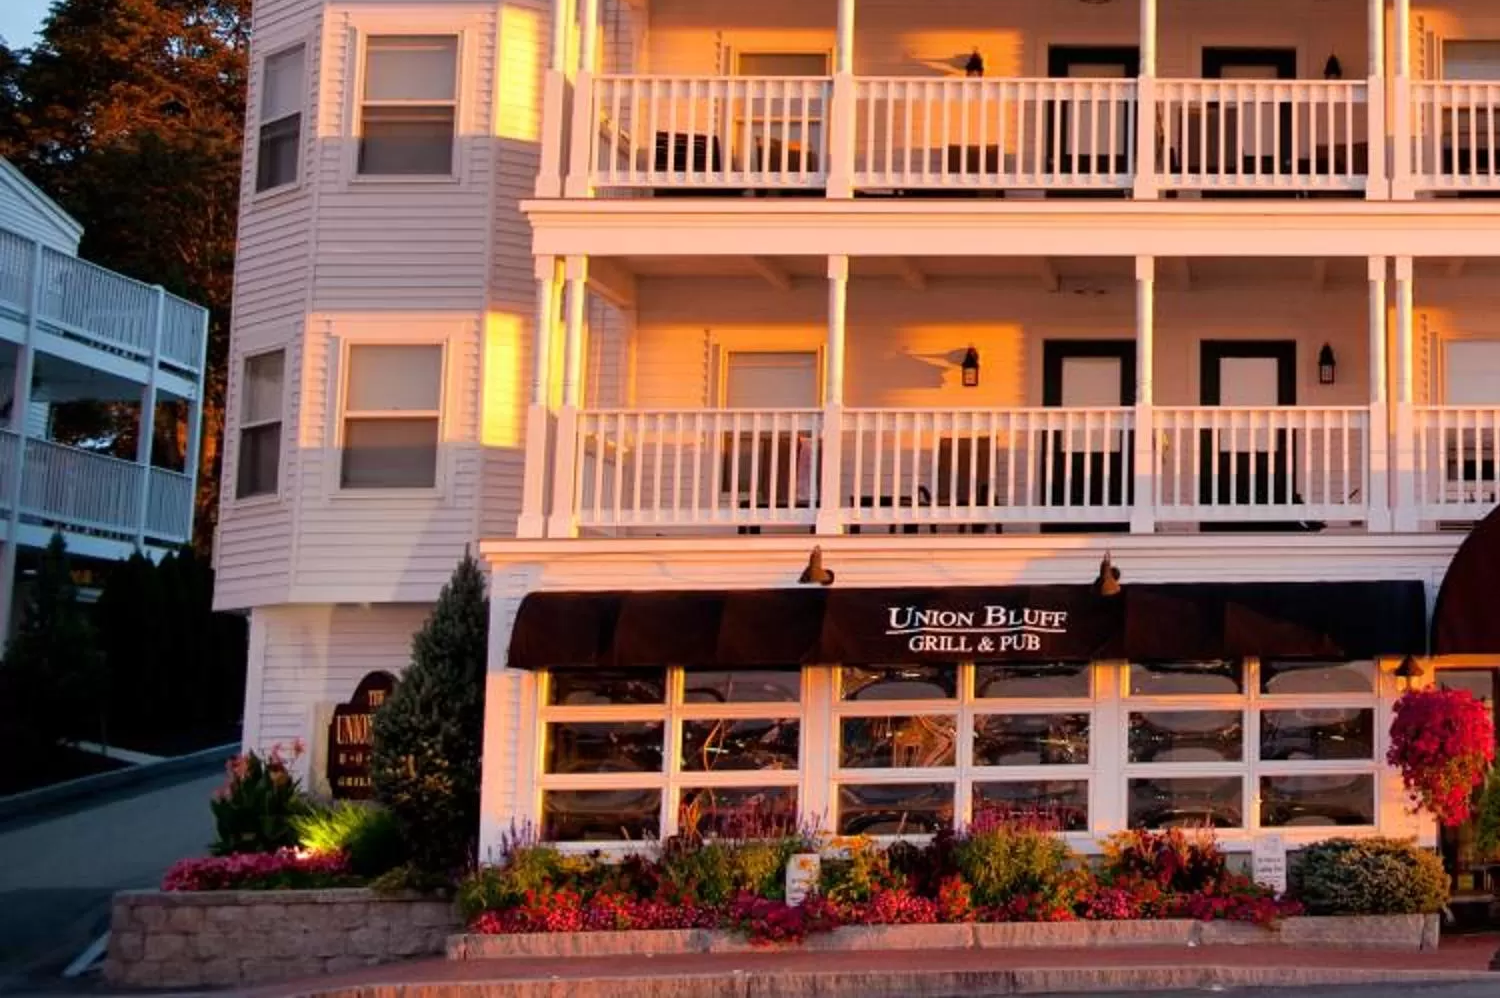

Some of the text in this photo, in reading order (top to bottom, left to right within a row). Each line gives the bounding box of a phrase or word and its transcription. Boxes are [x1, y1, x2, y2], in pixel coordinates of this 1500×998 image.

[888, 605, 1067, 629] UNION BLUFF
[908, 634, 1041, 652] GRILL & PUB
